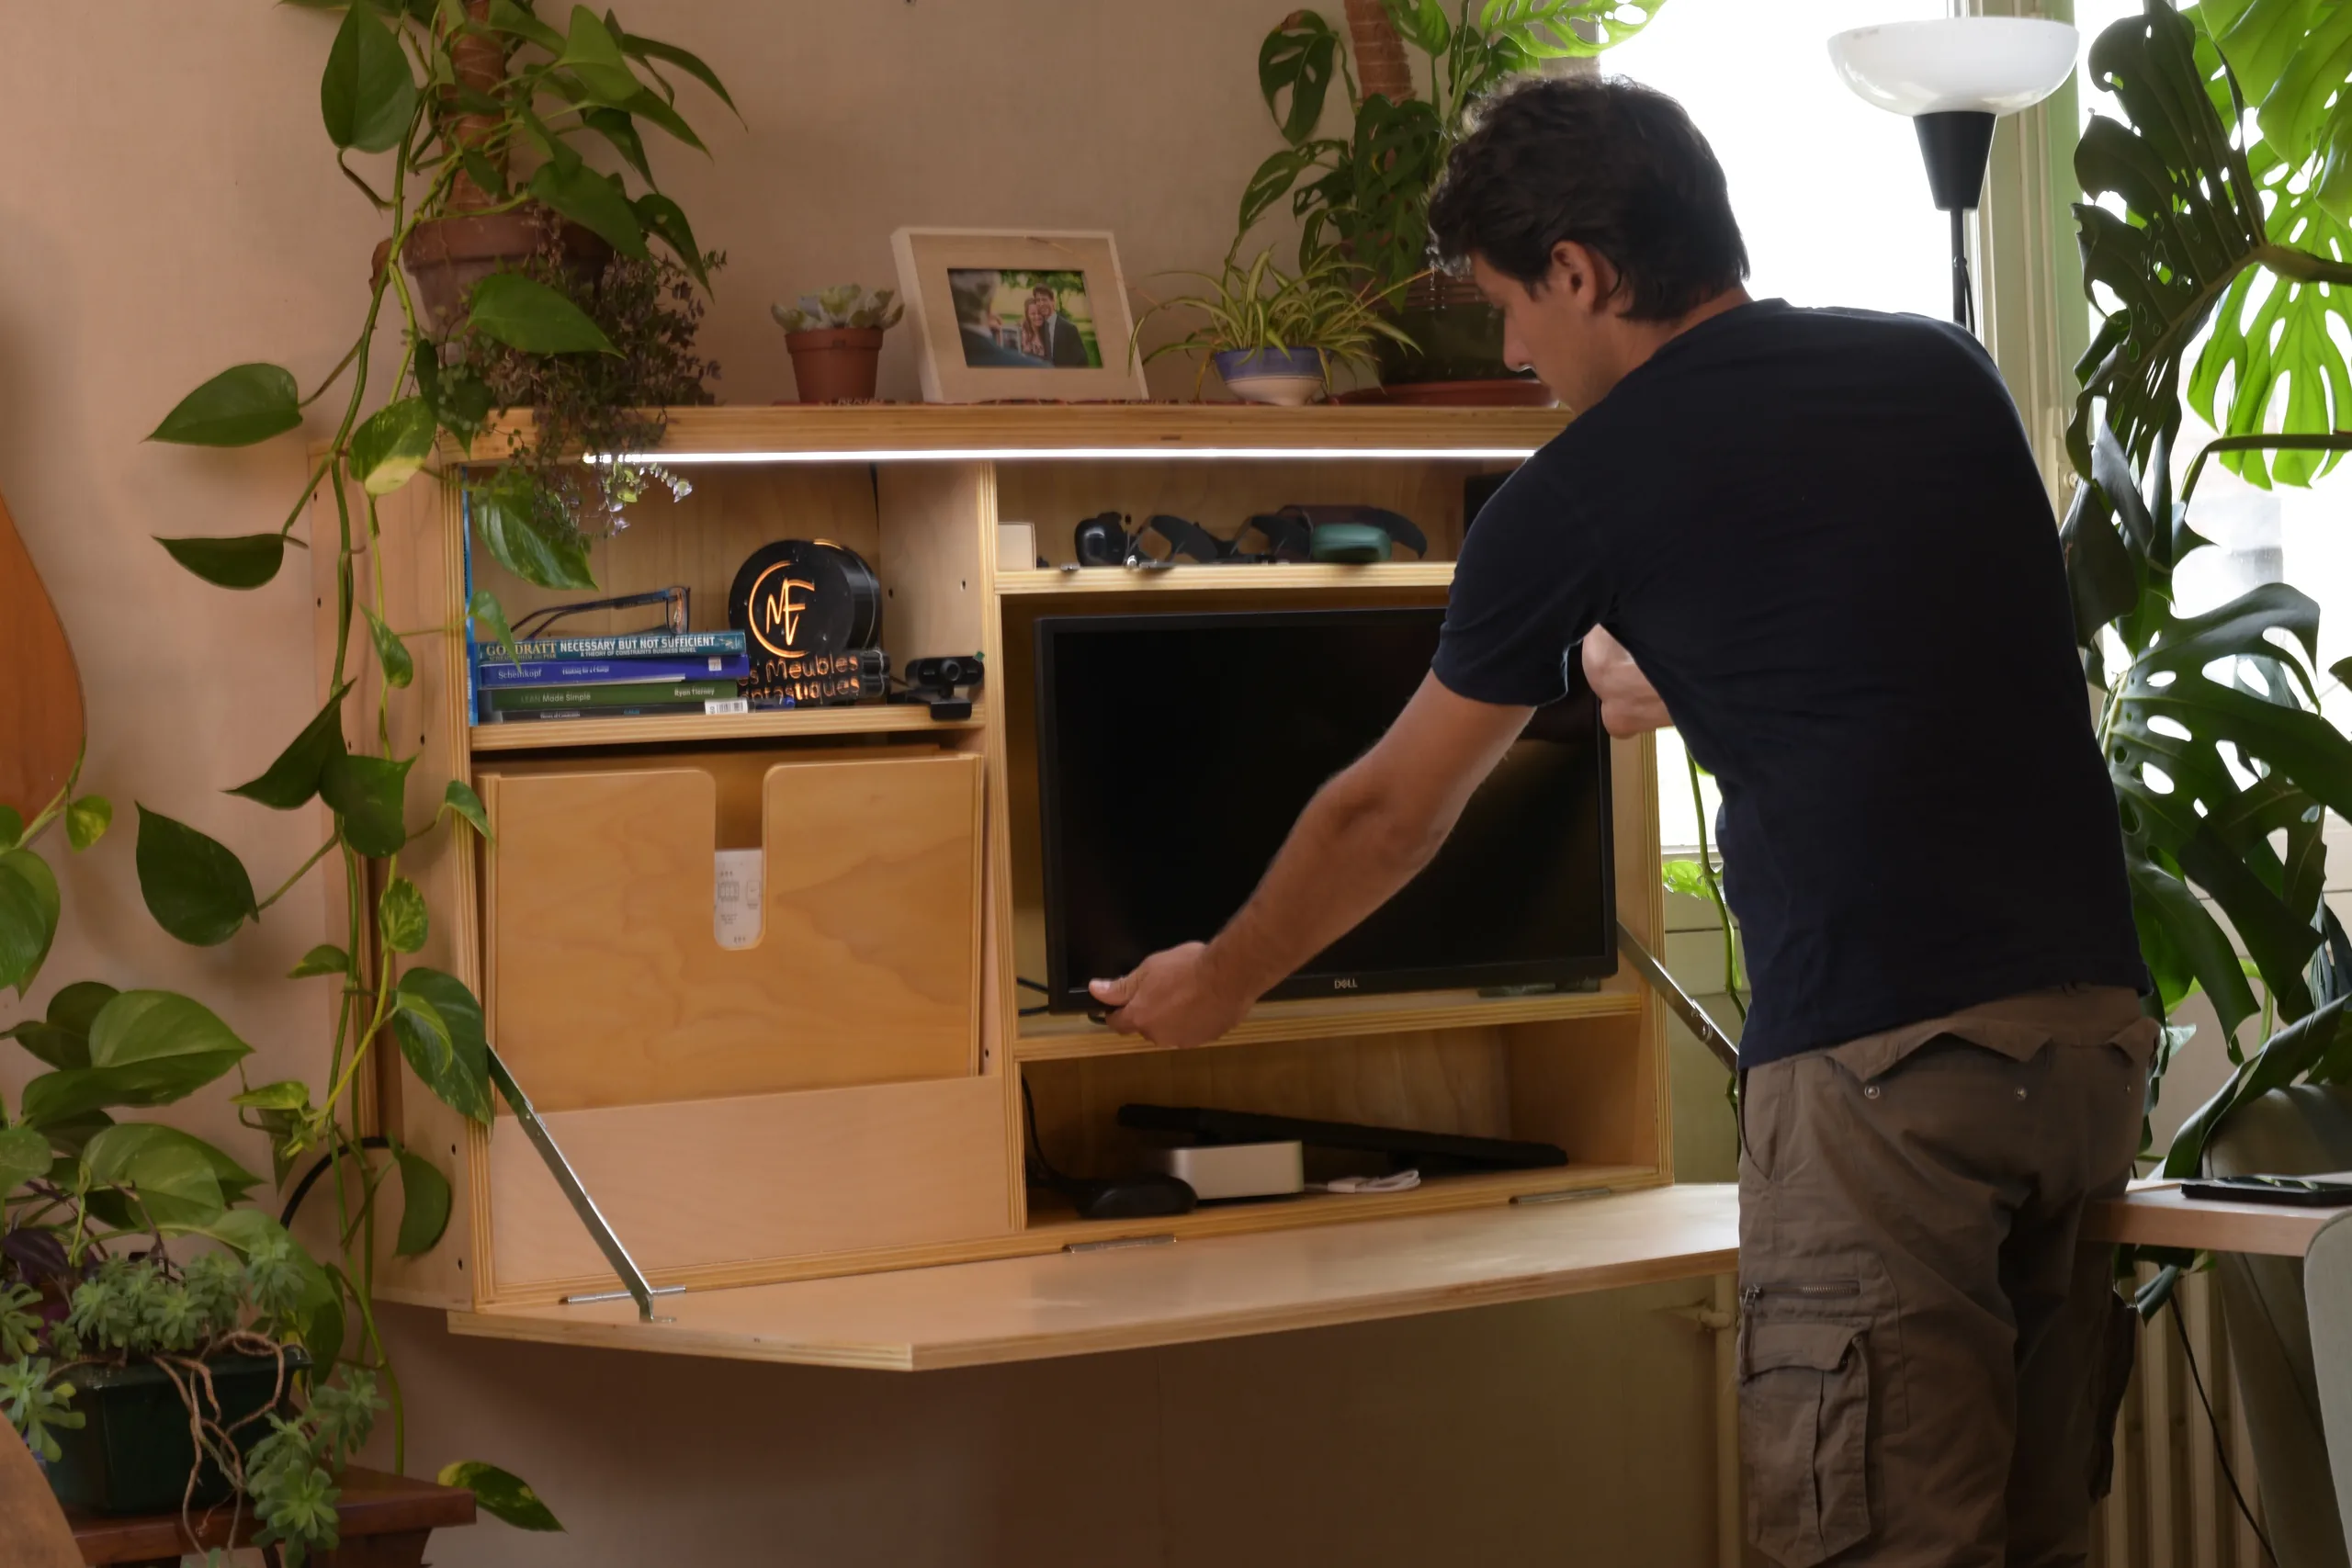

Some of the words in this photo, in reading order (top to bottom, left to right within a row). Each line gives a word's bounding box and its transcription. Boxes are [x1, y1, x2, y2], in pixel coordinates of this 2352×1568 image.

[486, 642, 557, 656] GODRATT
[560, 638, 616, 652] NECESSARY
[618, 638, 638, 649] BUT
[642, 637, 659, 649] NOT
[662, 636, 716, 648] SUFFICIENT
[616, 648, 651, 656] CONSTRAINTS
[765, 654, 859, 682] Meubles
[542, 694, 564, 703] Made
[565, 692, 591, 702] Simple
[674, 688, 691, 696] Ryan
[1334, 978, 1358, 989] DELL
